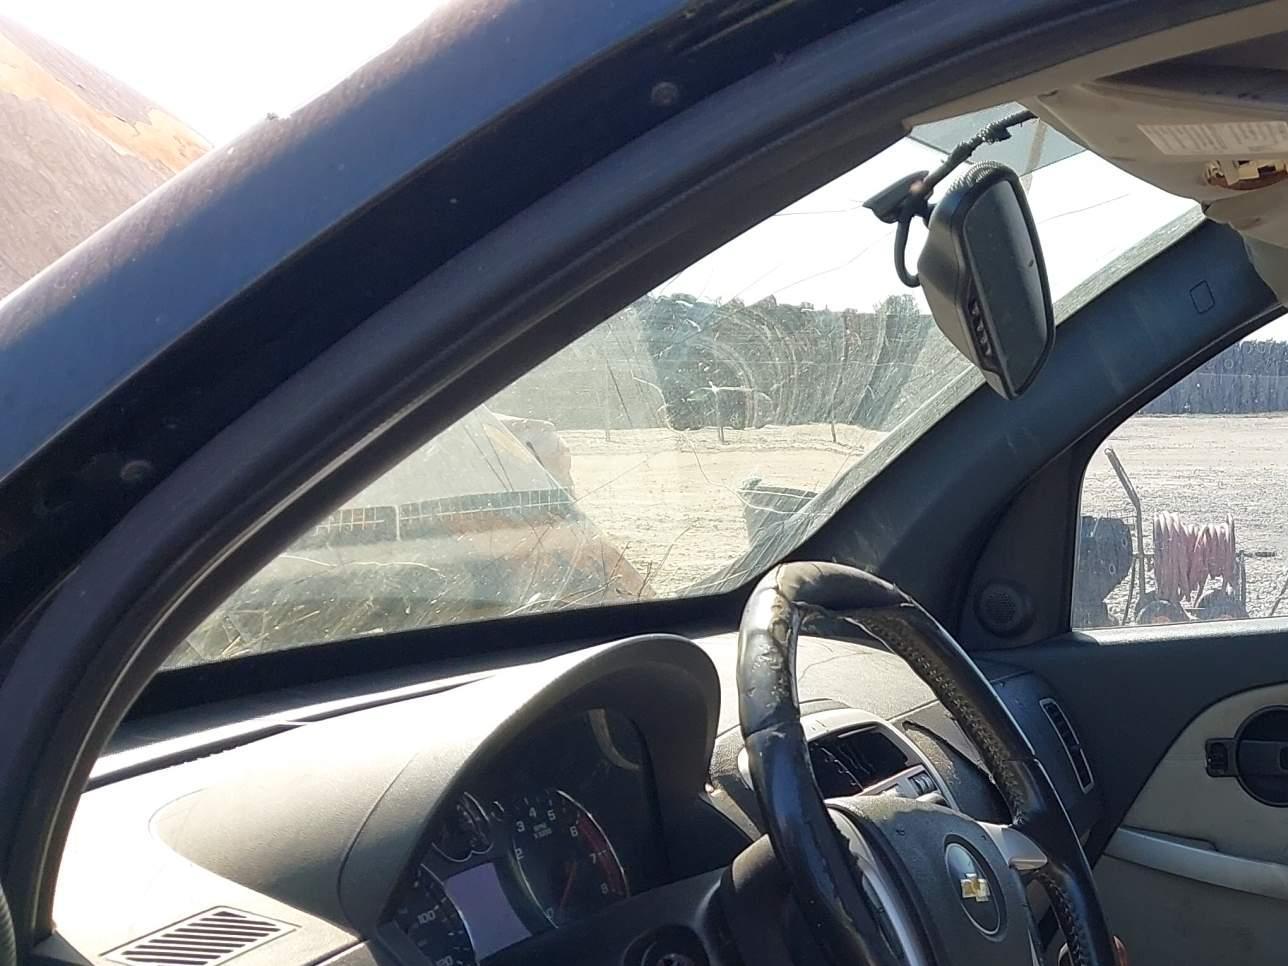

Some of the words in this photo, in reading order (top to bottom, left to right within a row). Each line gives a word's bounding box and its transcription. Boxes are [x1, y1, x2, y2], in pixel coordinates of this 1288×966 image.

[529, 807, 537, 818] 4
[547, 809, 556, 821] 5
[516, 820, 525, 832] 3
[570, 825, 579, 838] 6
[590, 853, 597, 864] 7
[600, 882, 609, 895] 8
[417, 909, 436, 925] 100
